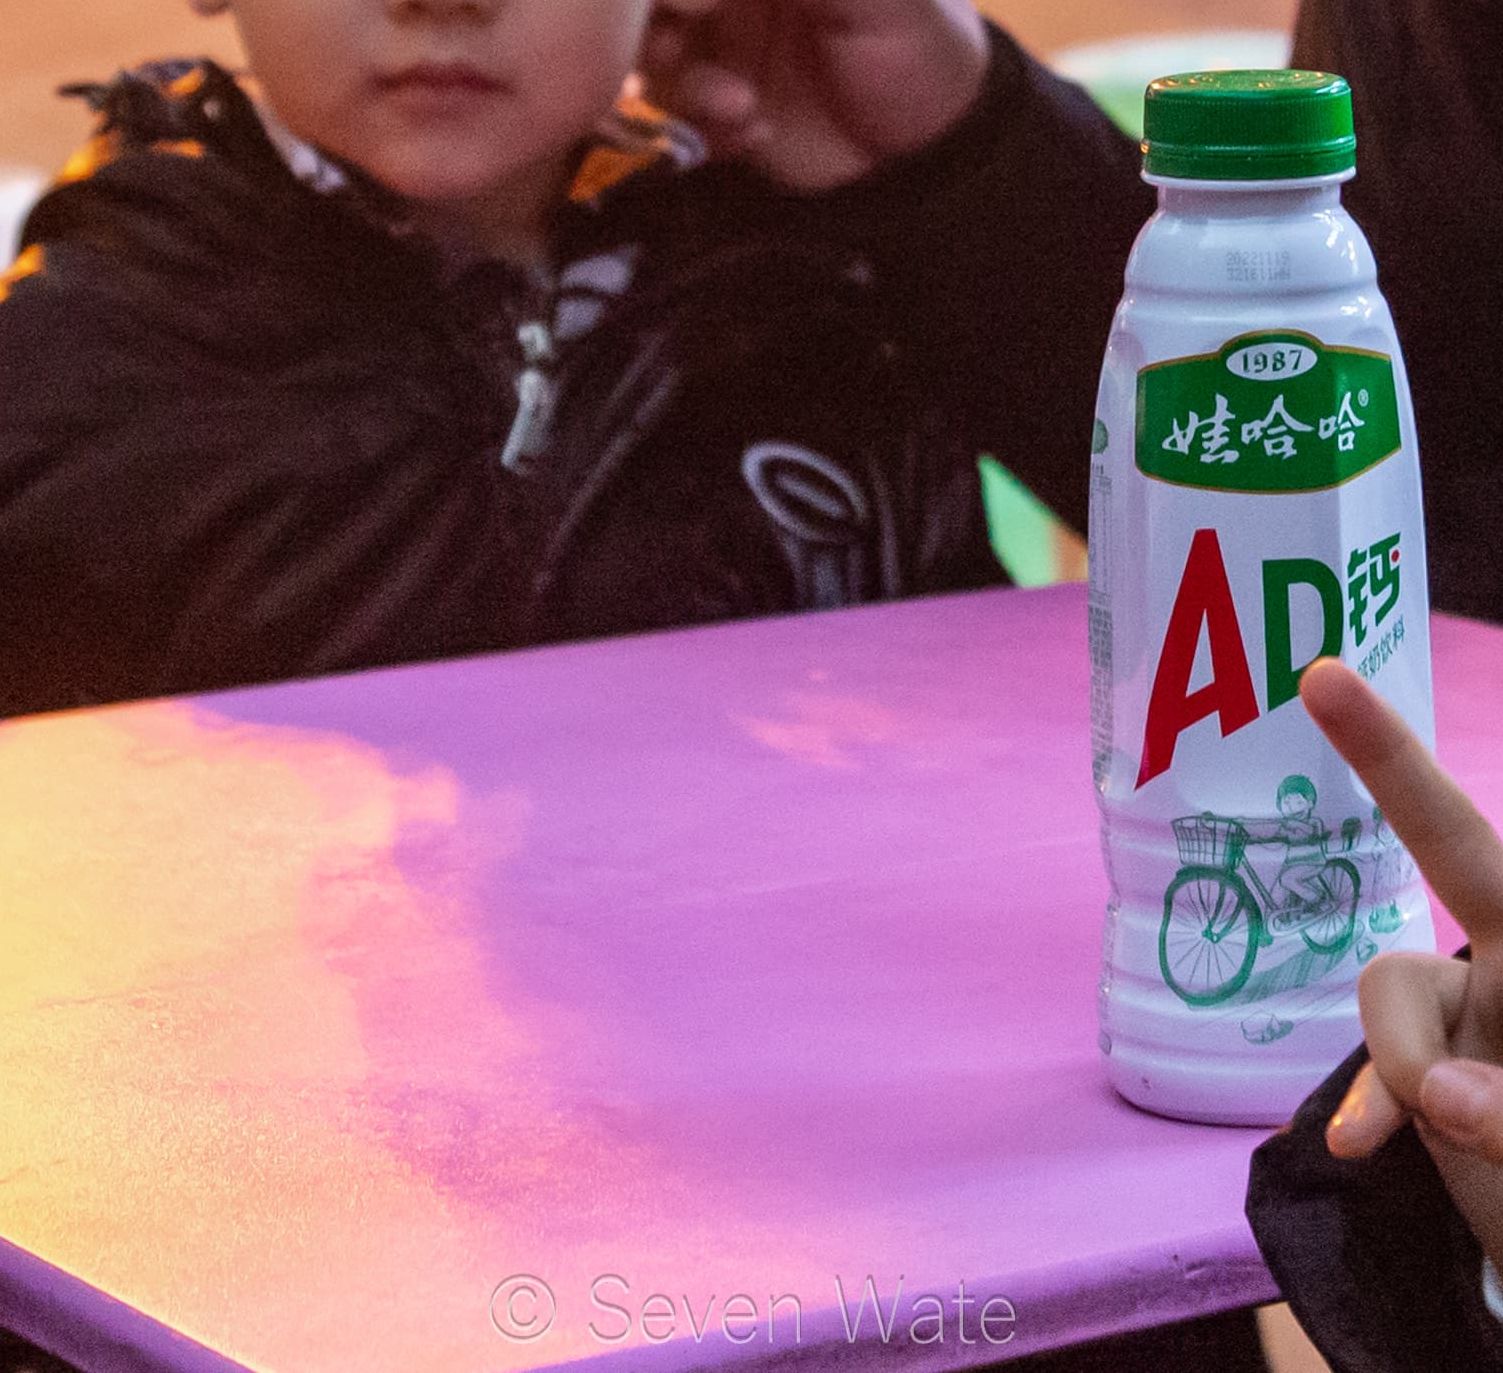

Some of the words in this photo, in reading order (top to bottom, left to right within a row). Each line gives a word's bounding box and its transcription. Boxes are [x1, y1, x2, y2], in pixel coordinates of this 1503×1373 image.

[1242, 348, 1302, 374] 1987
[1162, 391, 1366, 464] 娃哈哈
